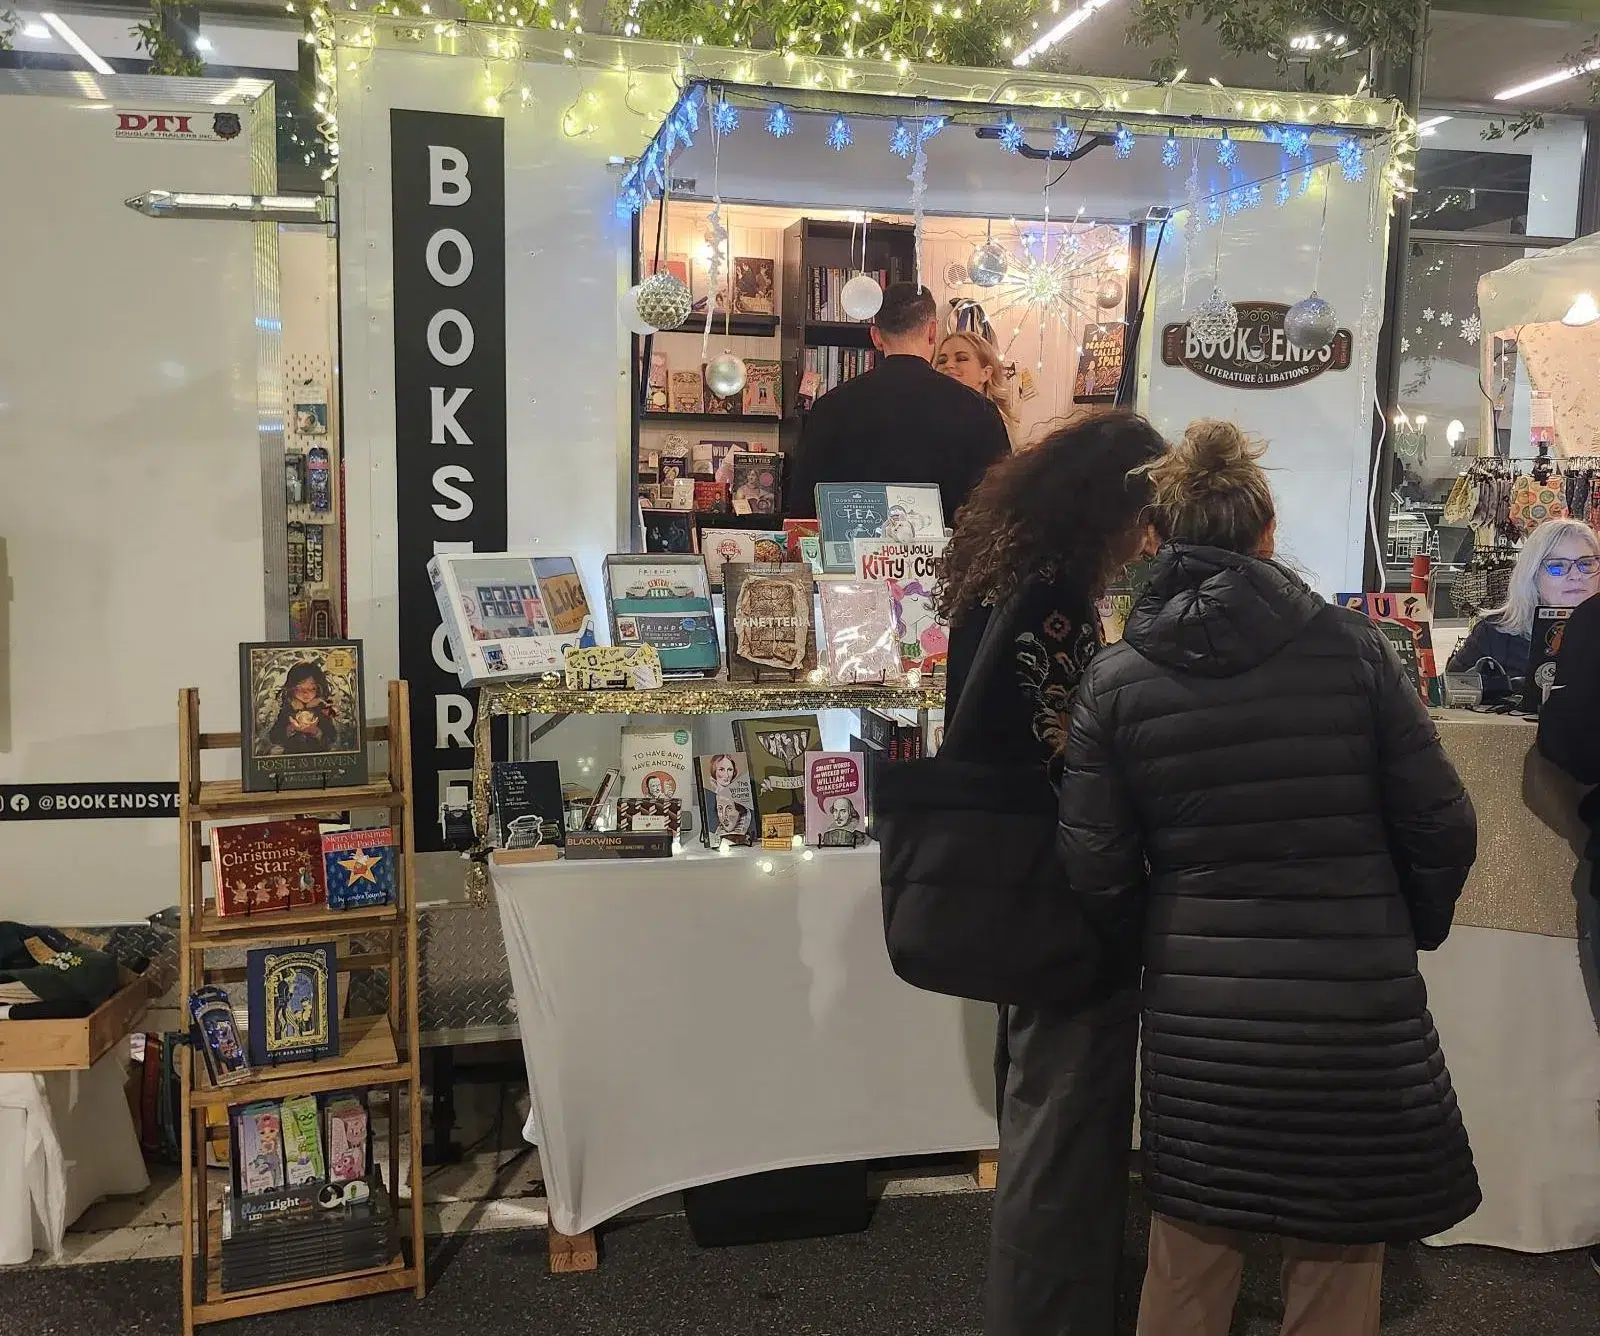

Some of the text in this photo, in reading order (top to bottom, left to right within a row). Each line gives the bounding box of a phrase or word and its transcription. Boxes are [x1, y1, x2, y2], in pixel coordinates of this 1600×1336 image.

[116, 114, 192, 132] DTI
[1093, 348, 1120, 356] CALLED
[1204, 364, 1309, 383] LITERATURE & LIBATIONS
[844, 509, 875, 519] TEA
[910, 544, 934, 557] JOLLY
[733, 617, 811, 627] PANETTERIA
[632, 753, 644, 761] TO
[667, 752, 684, 760] AND
[257, 758, 296, 771] ROSIE
[632, 760, 686, 771] HAVE ANOTHER
[816, 761, 851, 772] SMART WORDS
[821, 769, 840, 777] WICKED
[817, 775, 846, 785] WILLIAM
[816, 780, 857, 792] SHAKESPEARE
[326, 835, 349, 844] Merry
[332, 839, 385, 849] Little Pookie
[567, 837, 622, 846] BLACKWING
[254, 841, 273, 850] The
[222, 847, 296, 867] Christmas
[248, 1213, 263, 1221] LED
